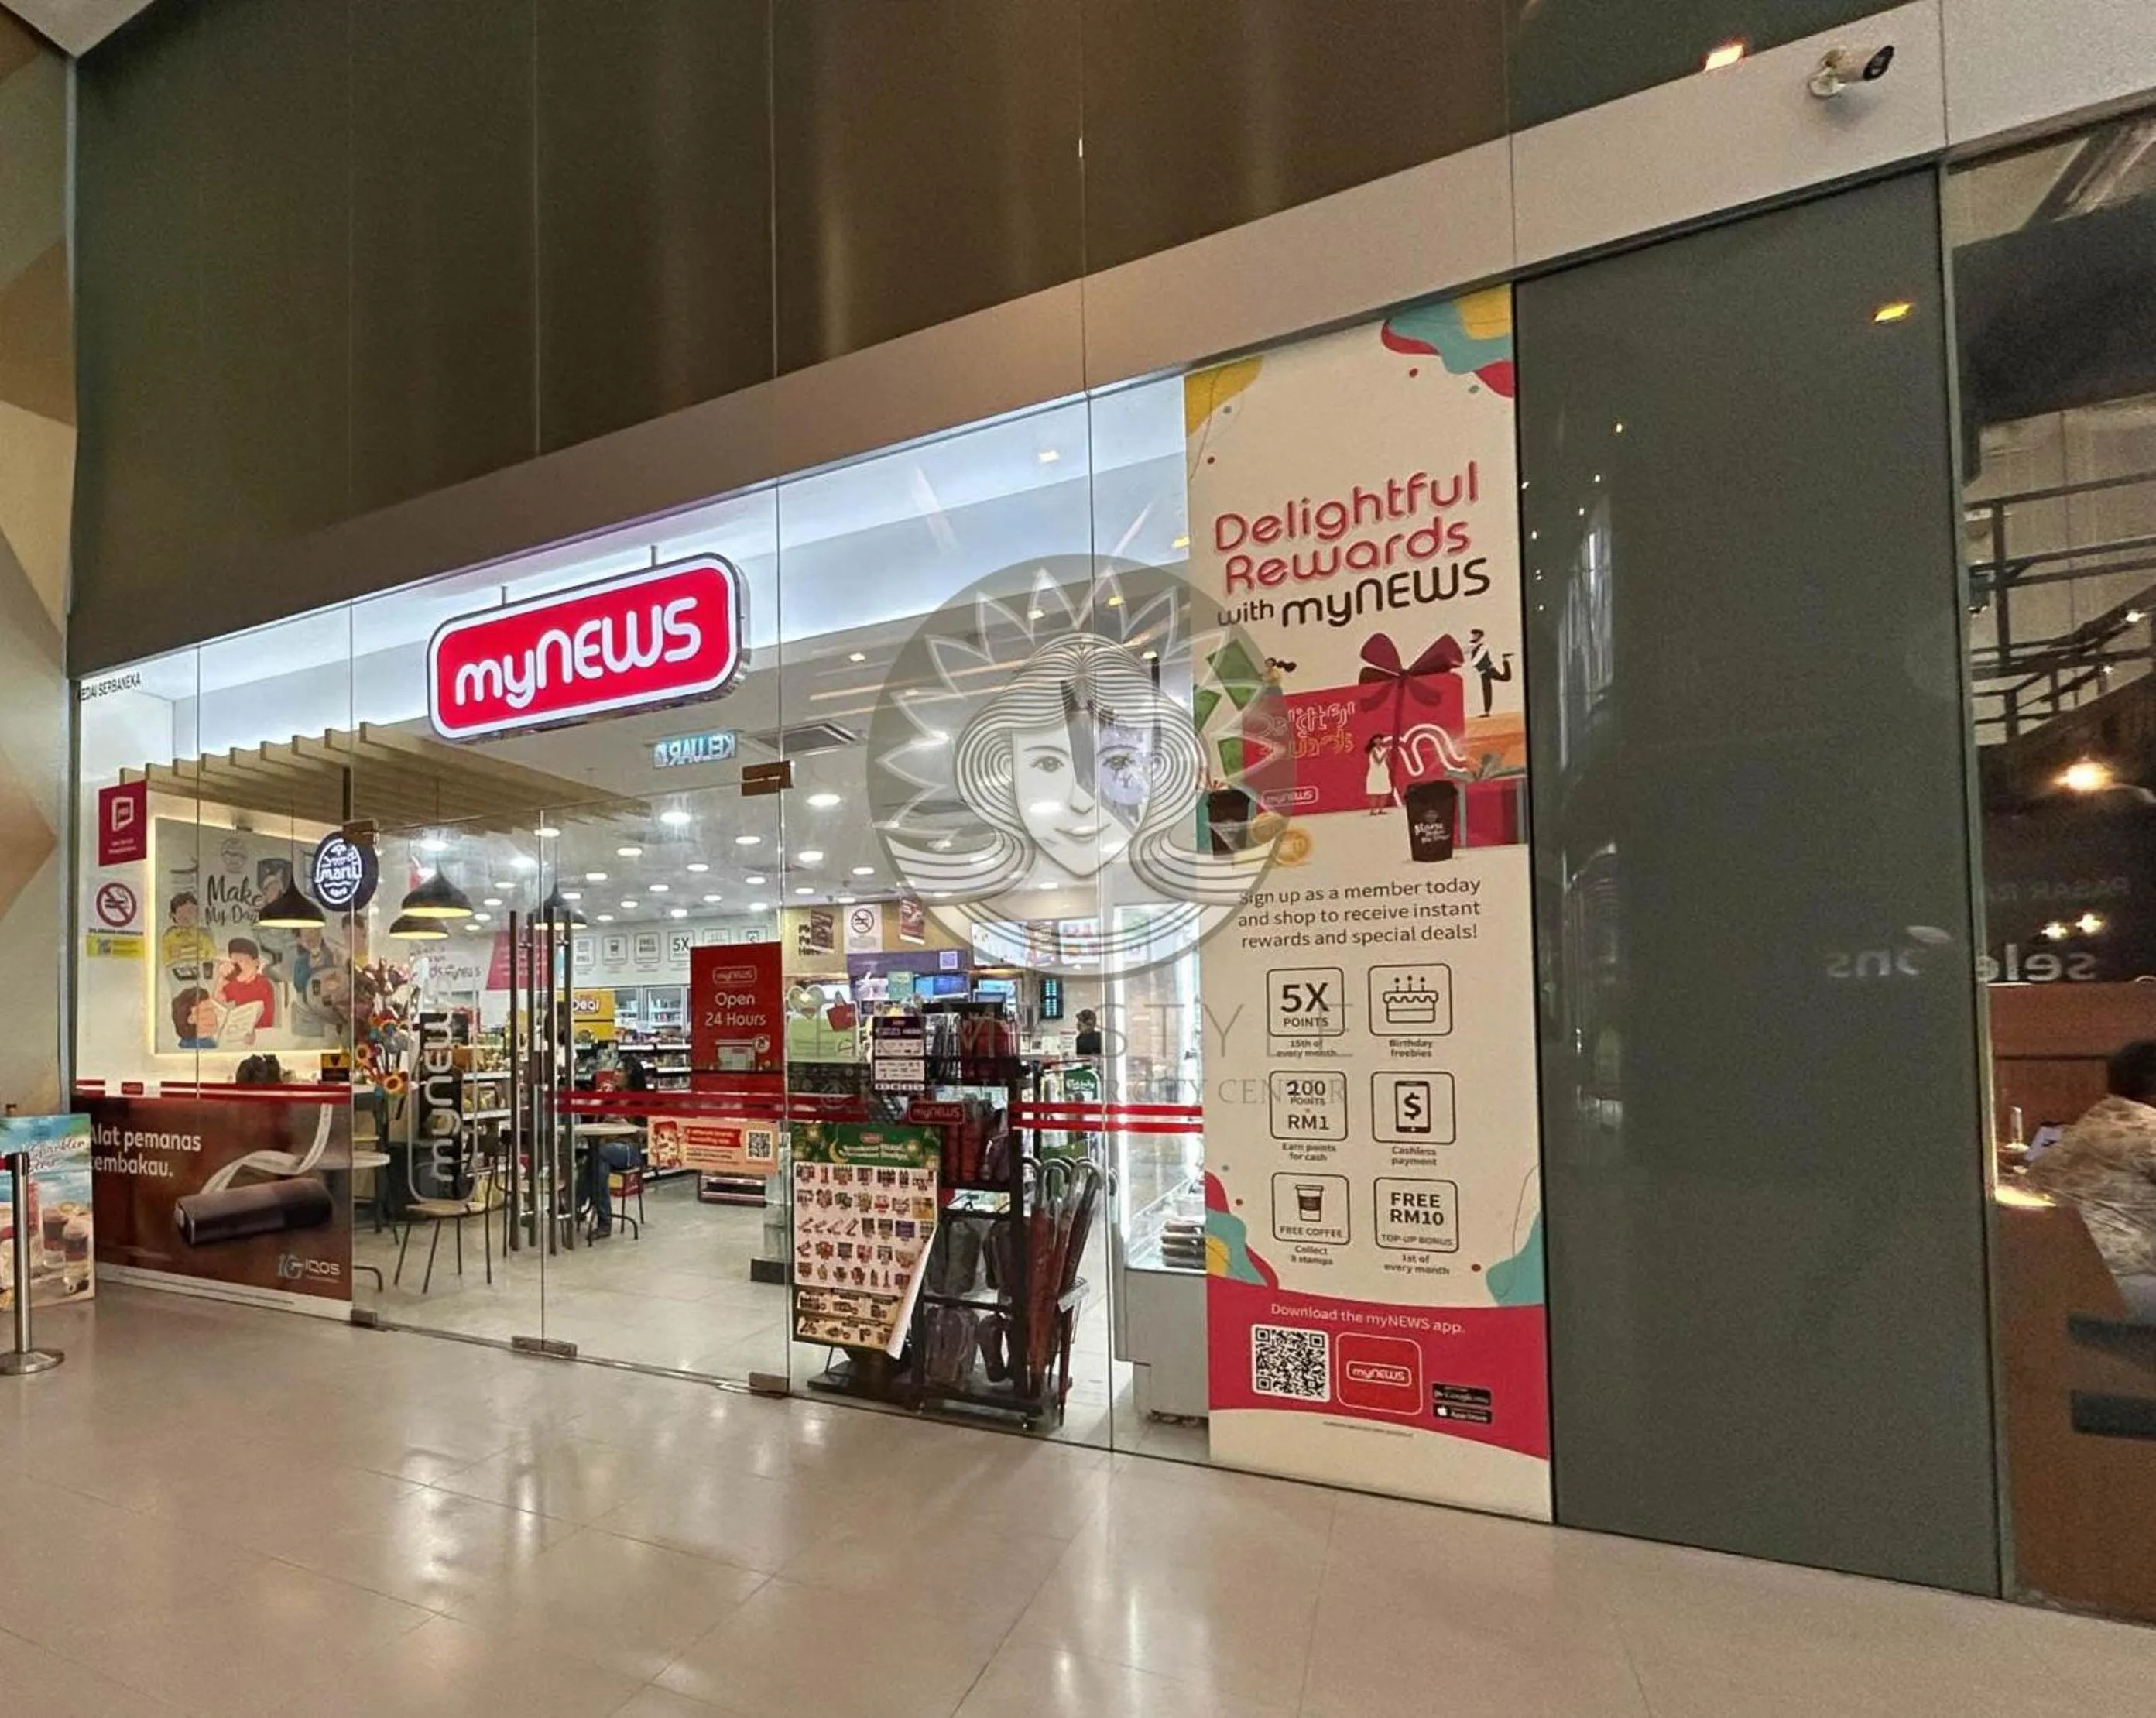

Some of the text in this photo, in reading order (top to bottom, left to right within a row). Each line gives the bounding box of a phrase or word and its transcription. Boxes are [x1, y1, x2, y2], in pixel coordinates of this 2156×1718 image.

[1215, 460, 1479, 552] Delightful
[1225, 516, 1472, 595] Rewards
[1217, 557, 1491, 627] with myNEWS
[455, 597, 701, 709] myNEWS
[207, 875, 263, 907] Make
[1239, 877, 1481, 907] Sign up as a member today
[205, 907, 225, 926] My
[1239, 901, 1482, 928] and shop to receive instant
[1242, 924, 1478, 948] rewards and special deals!
[715, 992, 756, 1009] Open
[1280, 982, 1329, 1013] 5X
[704, 1012, 766, 1026] 24 Hours
[1283, 1017, 1328, 1027] POINTS
[1290, 1039, 1311, 1048] 15th
[1389, 1038, 1433, 1048] Birthday
[1390, 1048, 1432, 1058] freebies
[1287, 1080, 1326, 1096] 200
[1290, 1096, 1326, 1106] POINTS
[1287, 1115, 1330, 1131] RM1
[124, 1130, 201, 1152] pemanas
[1282, 1142, 1337, 1154] Earn points
[1289, 1152, 1327, 1161] for cash
[1392, 1146, 1436, 1157] Cashless
[1391, 1157, 1437, 1167] payment
[1390, 1192, 1441, 1209] FREE
[1390, 1209, 1445, 1226] RM10
[1280, 1226, 1342, 1238] FREE COFFEE
[1381, 1234, 1453, 1246] TOP-UP BONUS
[1295, 1245, 1328, 1254] Collect
[1298, 1257, 1333, 1265] stamps
[1402, 1253, 1431, 1264] 1st of
[306, 1258, 341, 1276] IQOS
[1384, 1264, 1450, 1275] every month
[1271, 1303, 1465, 1334] Download the myNEWS app.
